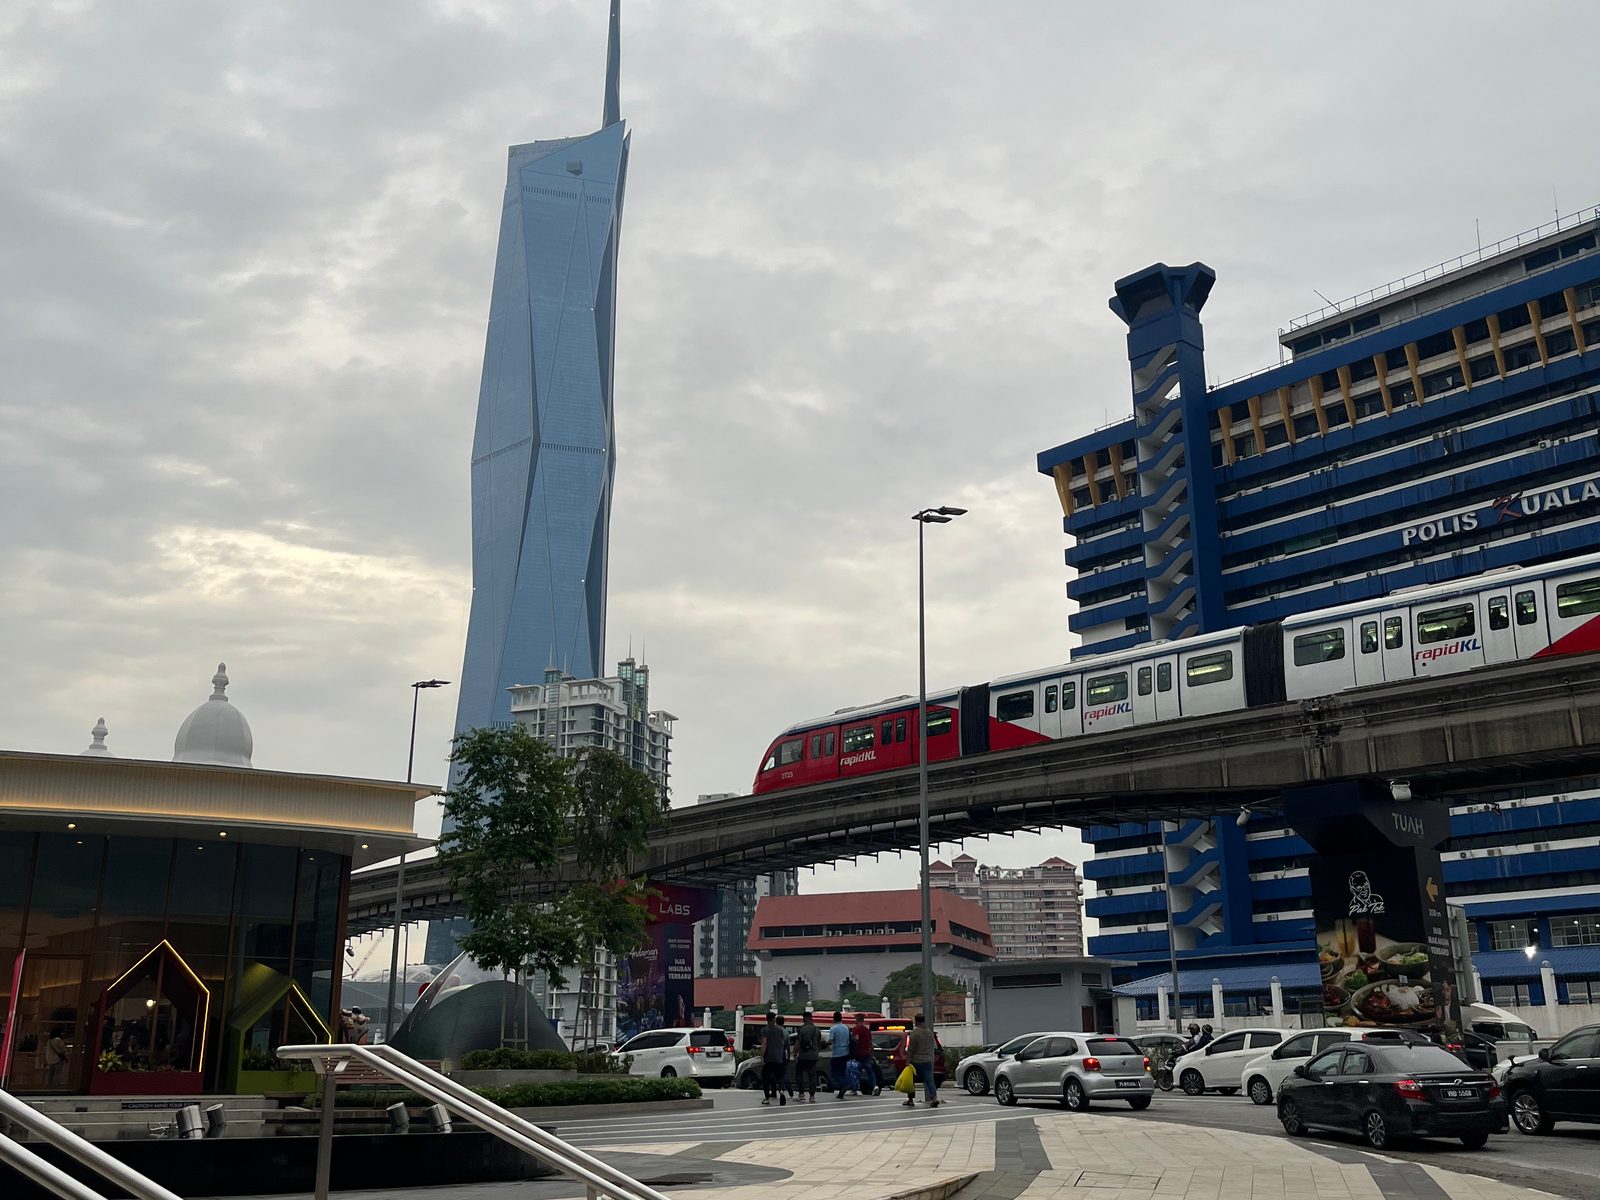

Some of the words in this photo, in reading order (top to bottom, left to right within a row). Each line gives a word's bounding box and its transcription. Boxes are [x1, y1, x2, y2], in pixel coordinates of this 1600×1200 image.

[1401, 511, 1478, 546] POLIS
[1415, 638, 1482, 661] rapidKL
[1084, 702, 1132, 720] rapidKL
[840, 750, 877, 766] rapidKL
[1391, 811, 1424, 835] TUAH
[659, 903, 691, 916] LABS
